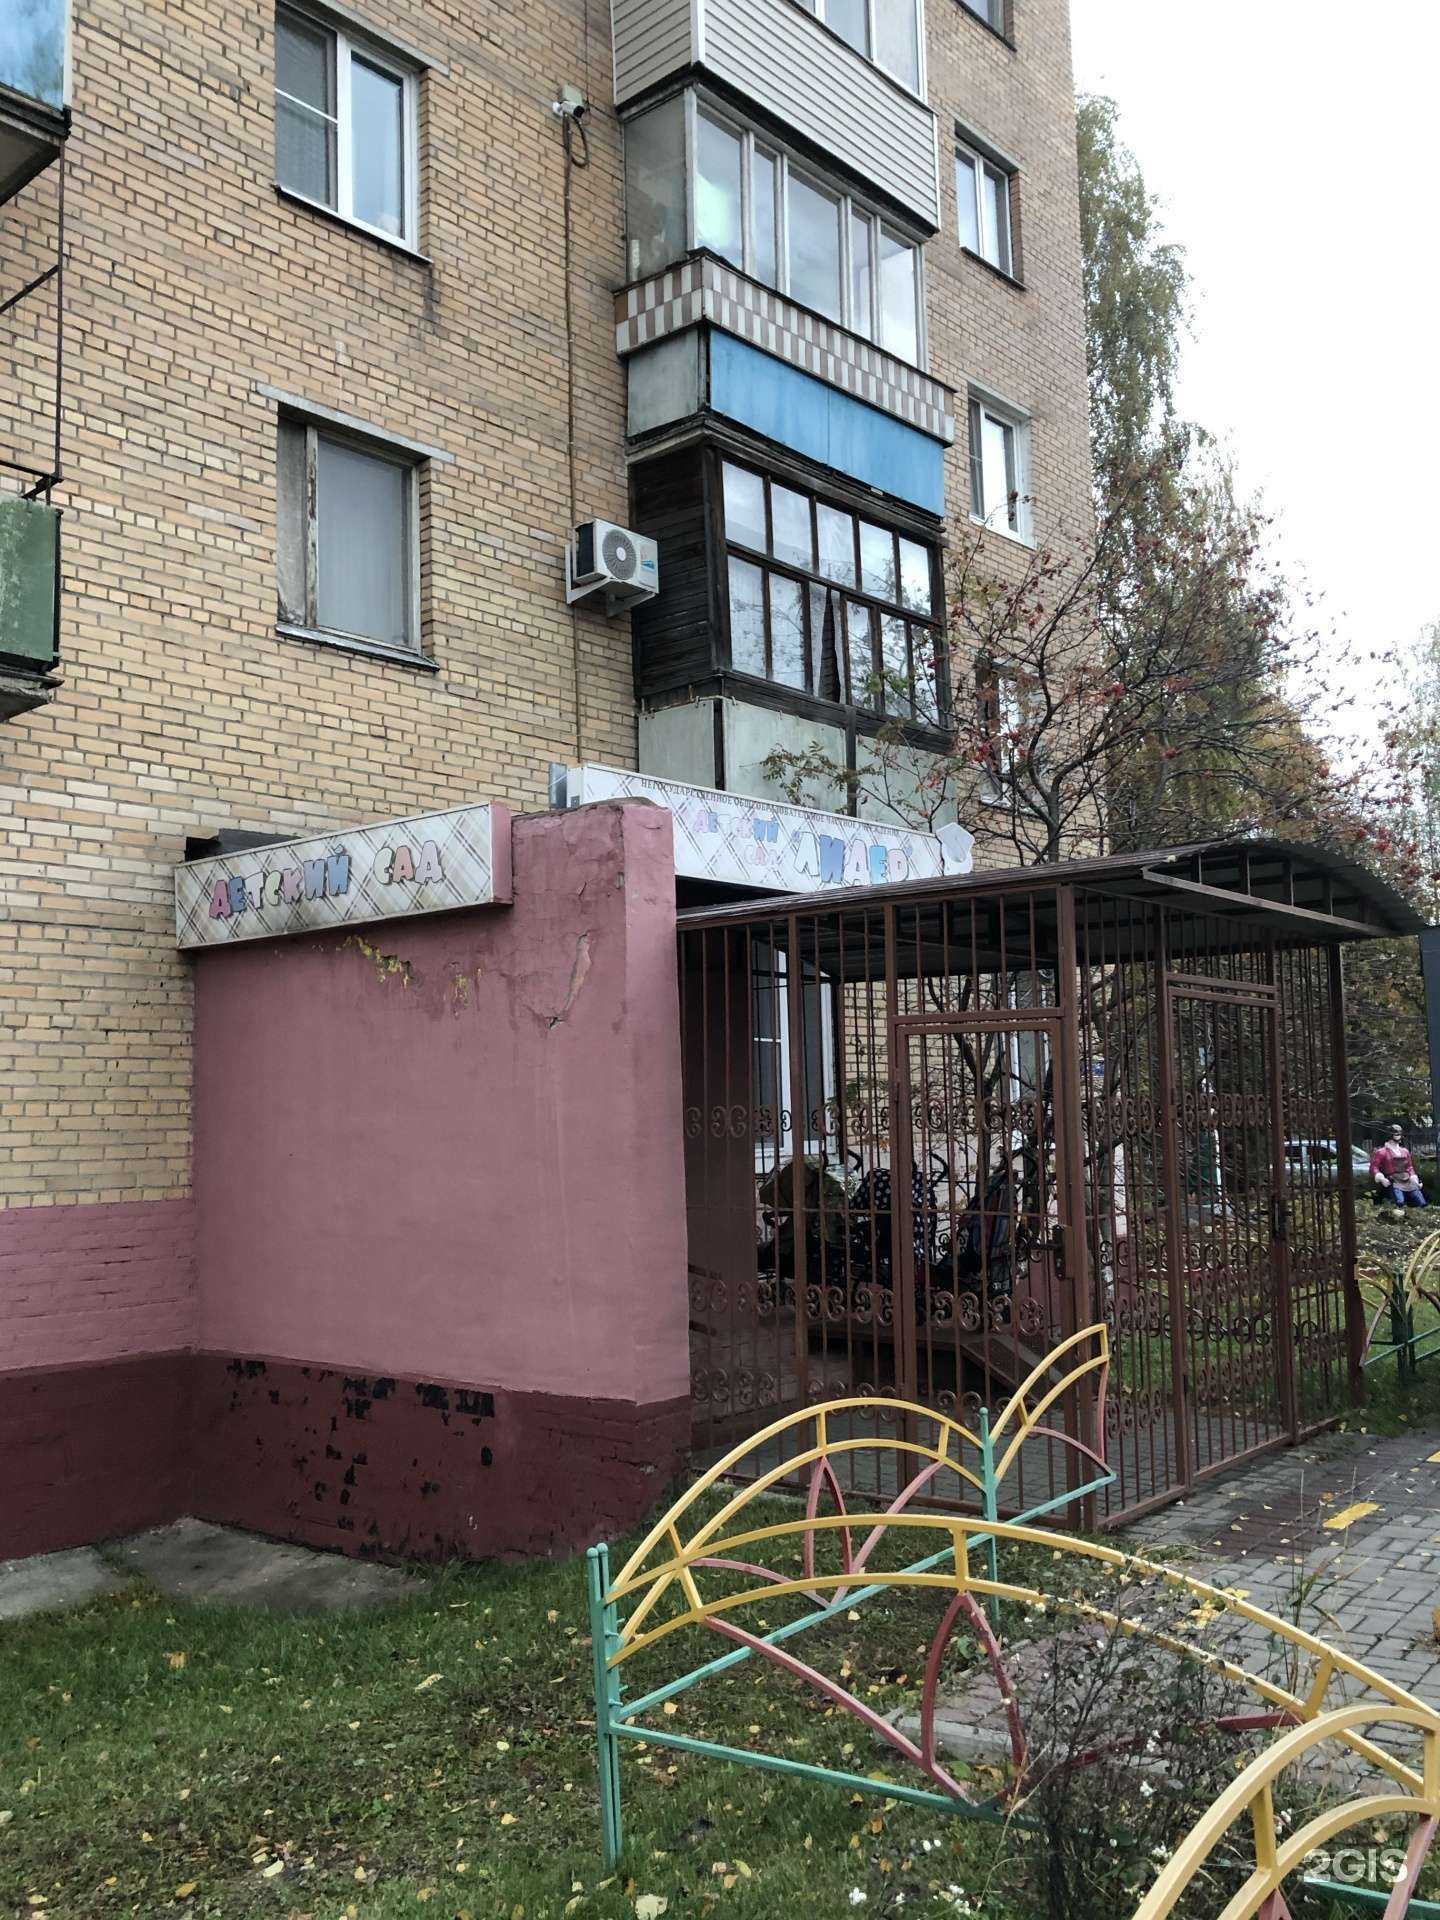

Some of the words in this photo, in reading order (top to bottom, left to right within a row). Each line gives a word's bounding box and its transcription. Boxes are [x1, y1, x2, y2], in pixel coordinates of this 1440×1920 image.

[693, 809, 779, 844] ДЕТСКИЙ
[743, 844, 781, 867] САД
[208, 843, 351, 920] ДЕТСКИЙ
[373, 839, 444, 886] САД
